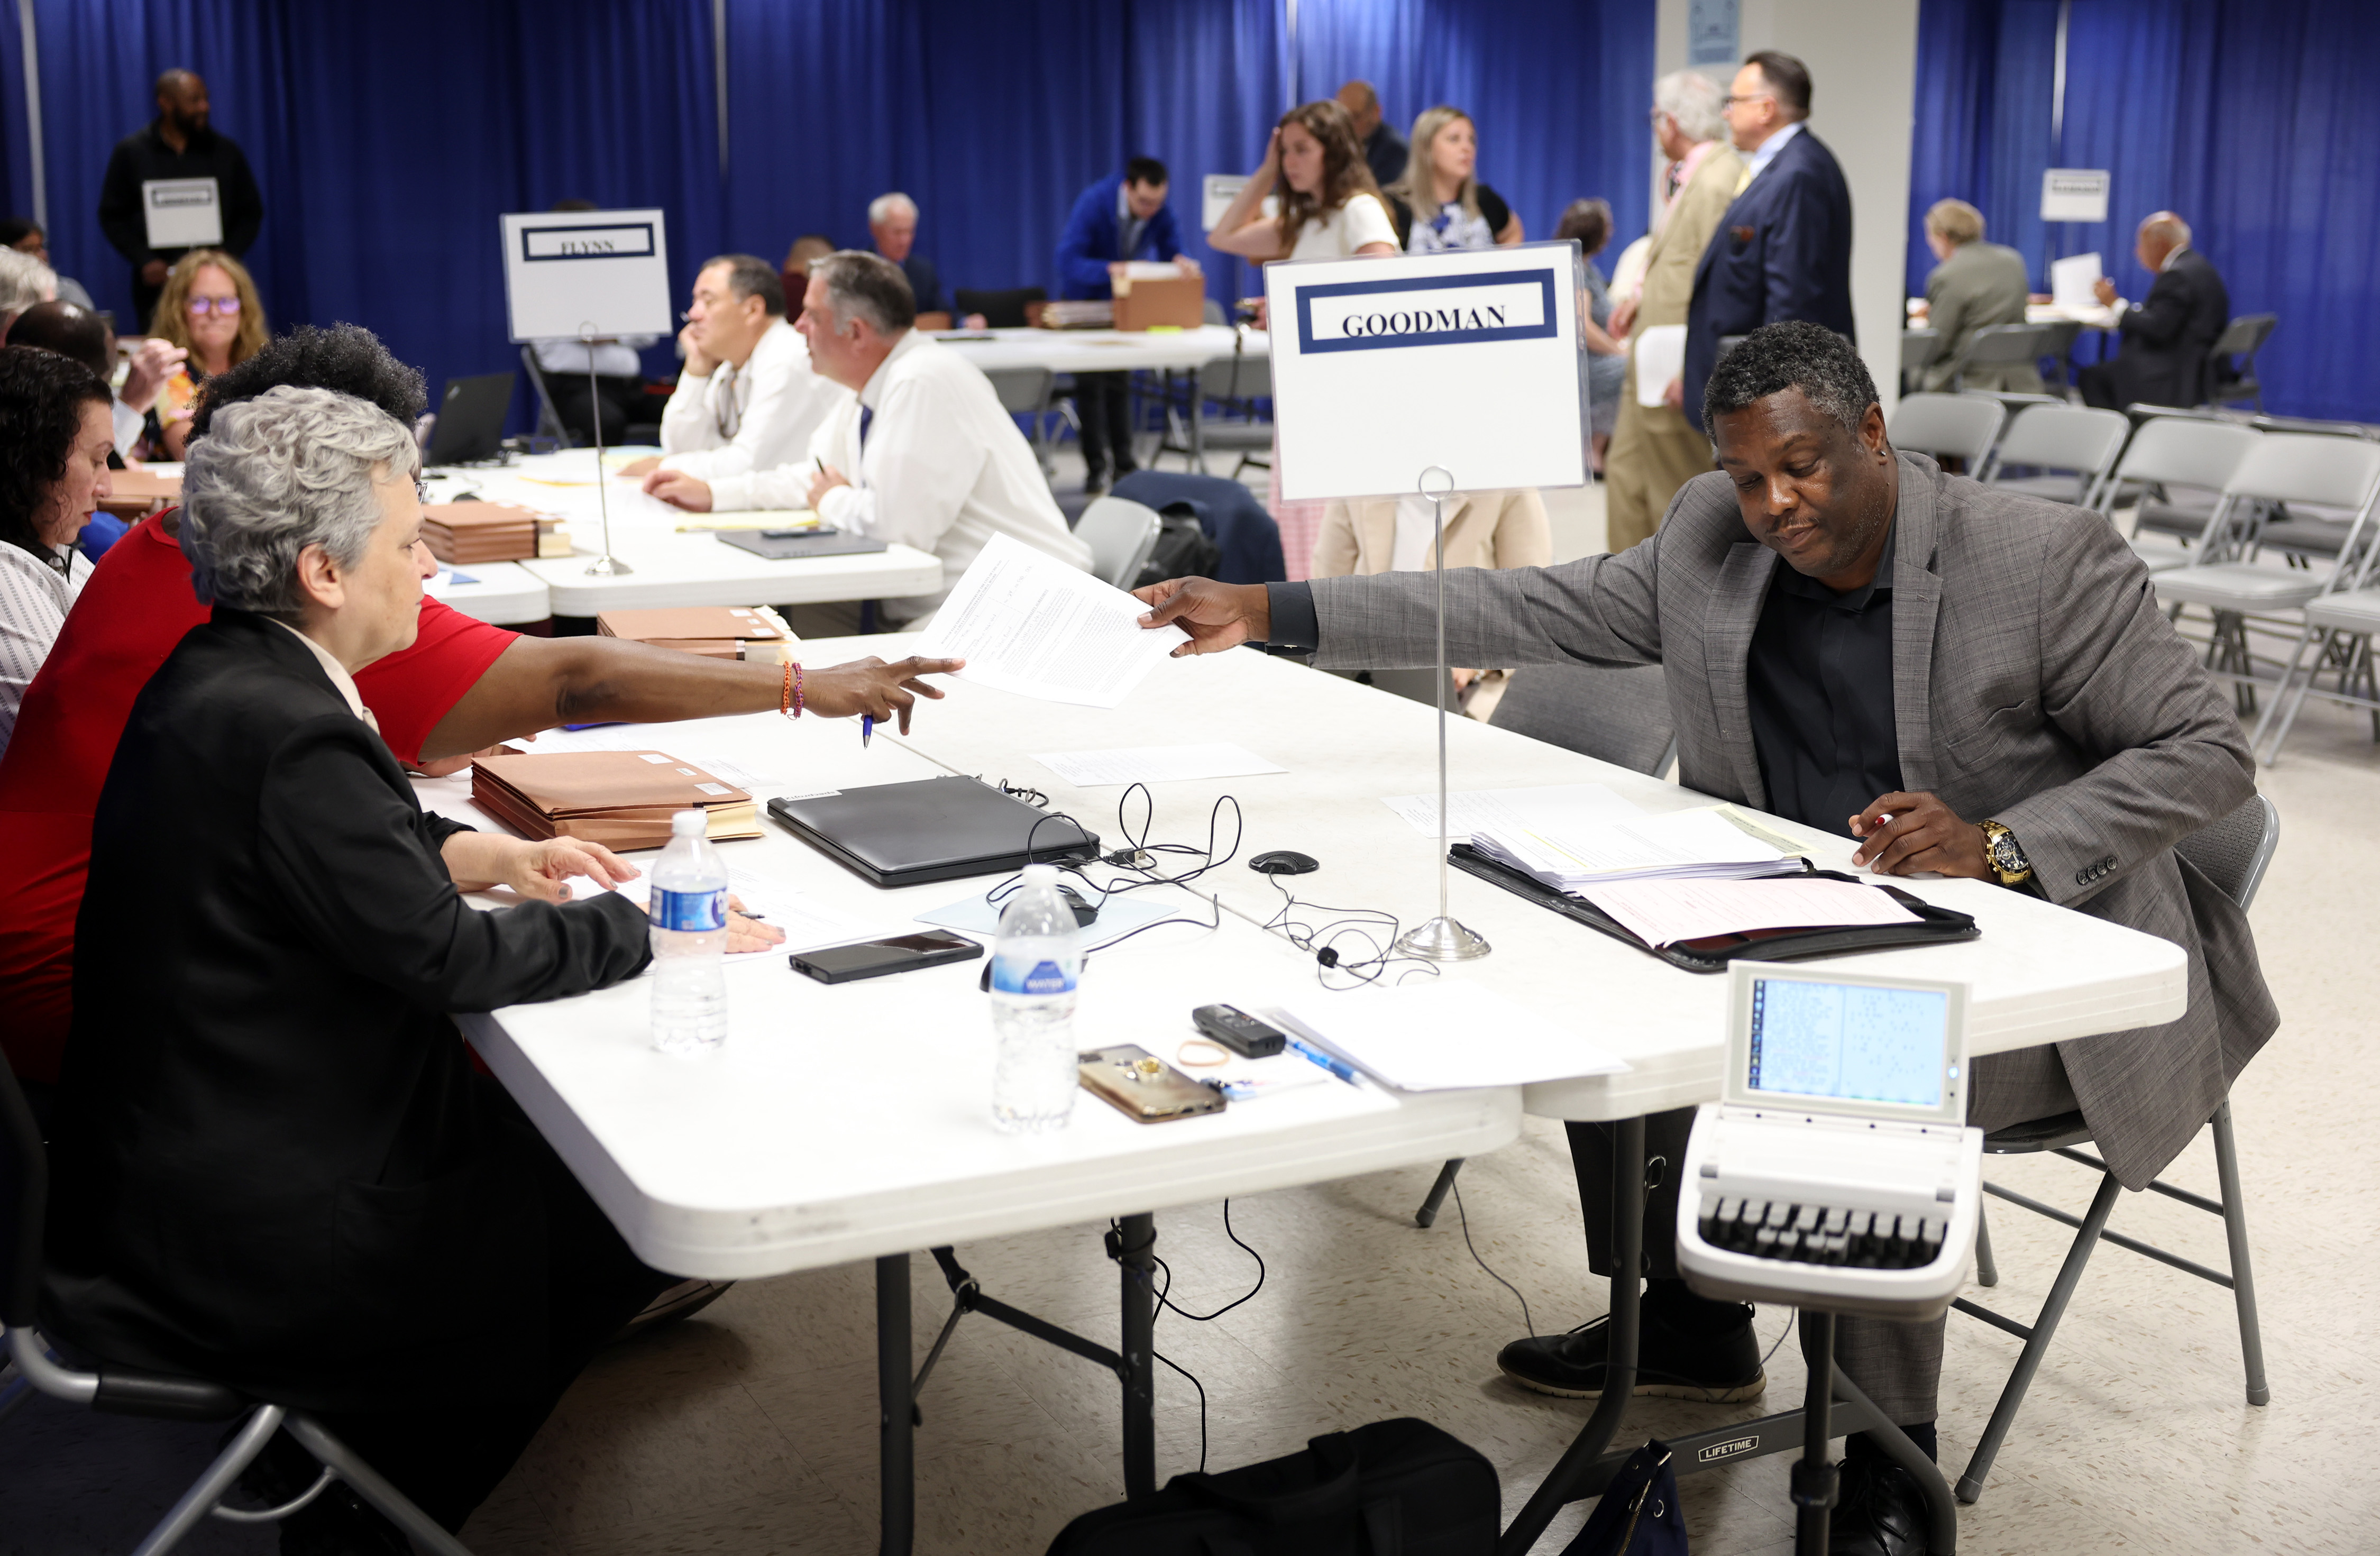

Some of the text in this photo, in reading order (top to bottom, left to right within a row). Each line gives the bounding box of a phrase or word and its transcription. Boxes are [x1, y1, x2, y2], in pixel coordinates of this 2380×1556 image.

[561, 240, 614, 255] FLYNN
[1343, 305, 1506, 338] GOODMAN
[1706, 1439, 1752, 1459] LIFETIME
